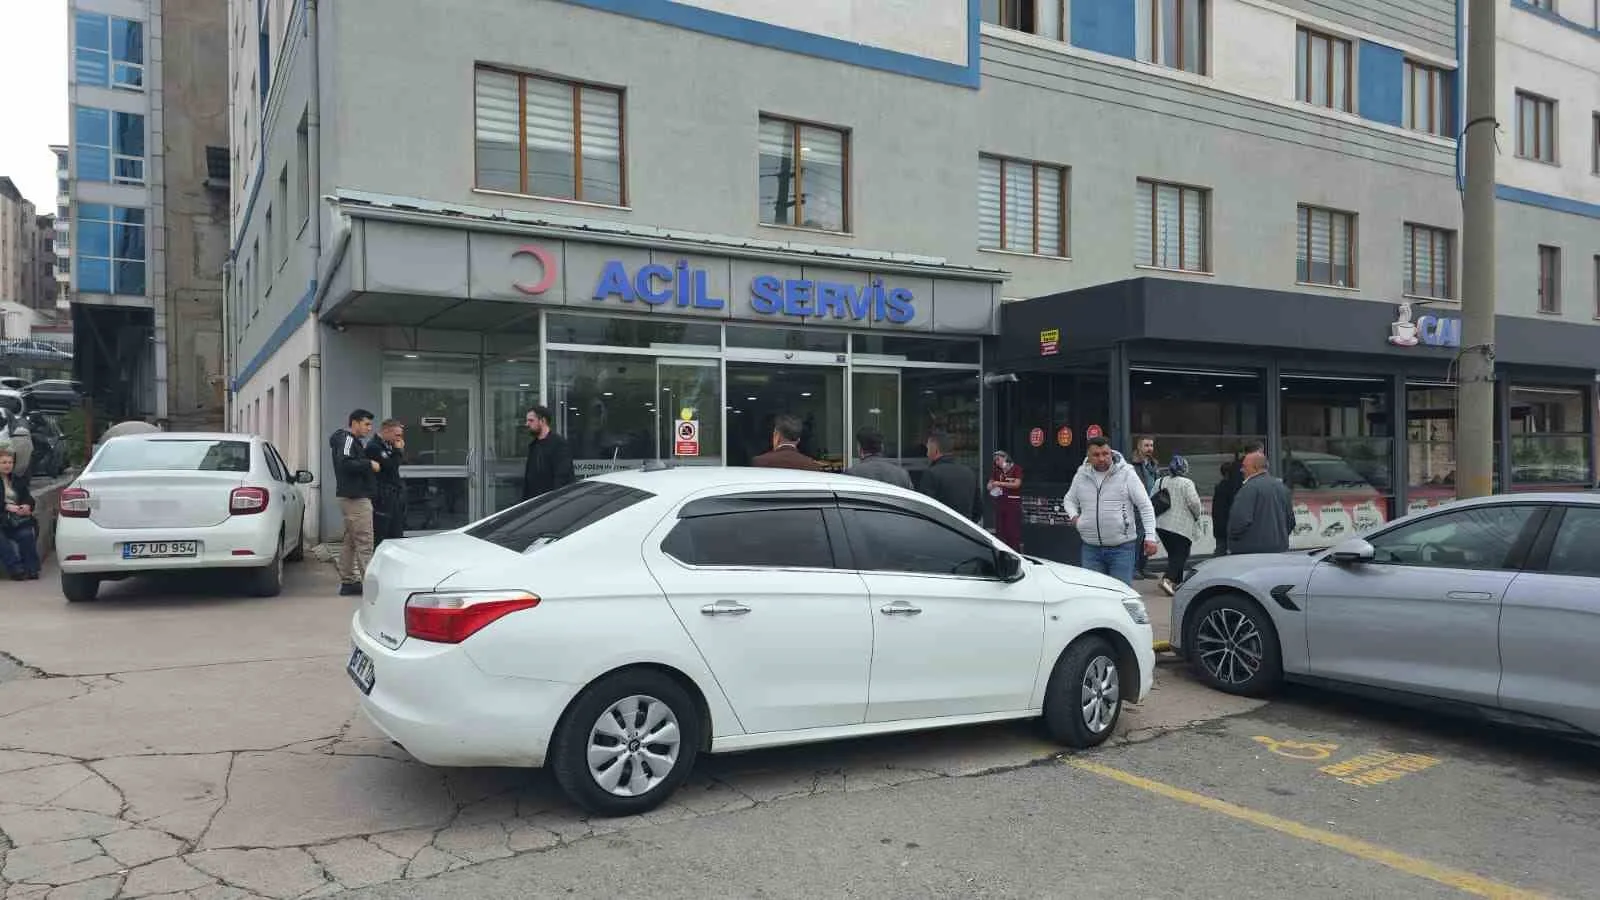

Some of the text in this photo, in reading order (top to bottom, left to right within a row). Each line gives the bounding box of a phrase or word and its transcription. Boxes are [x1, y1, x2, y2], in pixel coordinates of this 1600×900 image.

[592, 259, 916, 323] ACİL SERVİS
[130, 543, 195, 554] 67 UD 954
